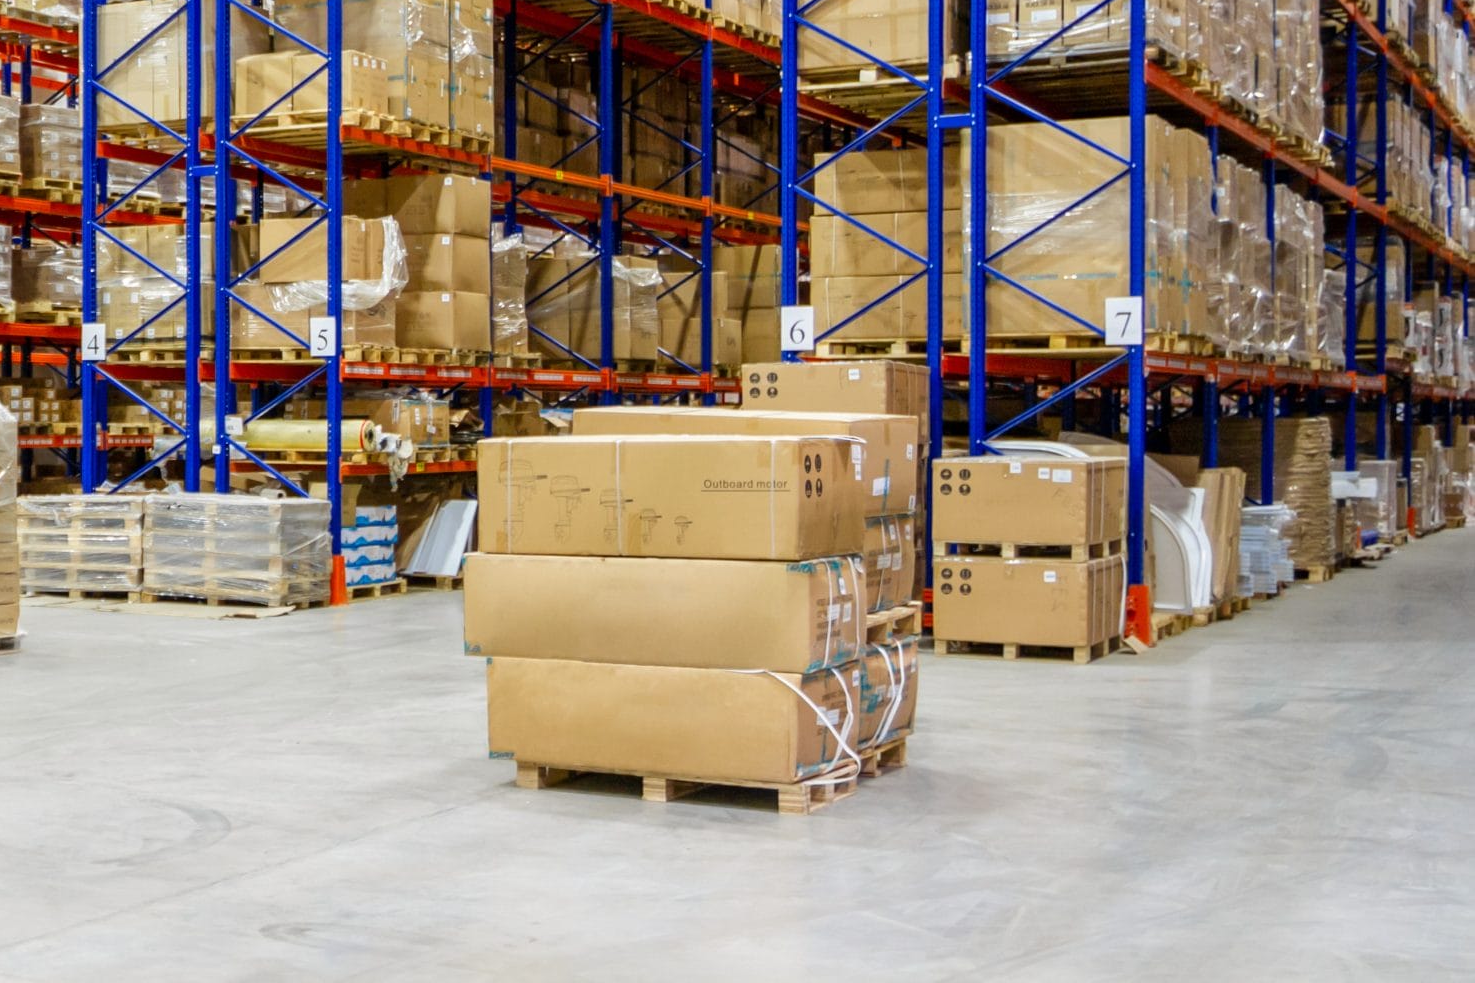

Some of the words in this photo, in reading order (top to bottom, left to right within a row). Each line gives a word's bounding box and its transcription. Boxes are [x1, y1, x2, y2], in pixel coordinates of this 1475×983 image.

[789, 319, 806, 345] 6
[1114, 312, 1132, 338] 7
[87, 334, 99, 355] 4
[316, 329, 328, 351] 5
[703, 478, 754, 489] Outboard
[756, 479, 788, 489] motor
